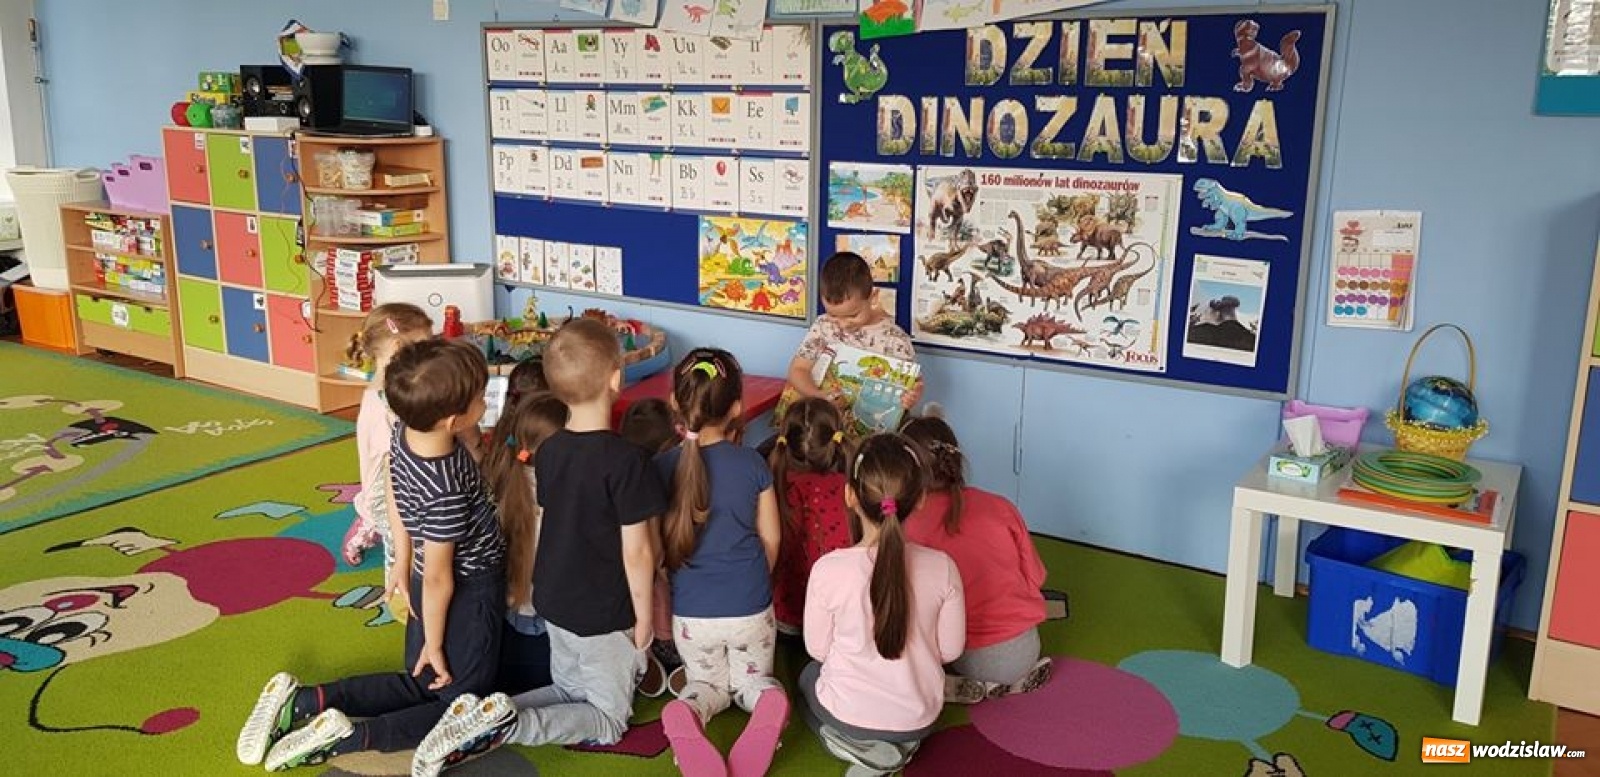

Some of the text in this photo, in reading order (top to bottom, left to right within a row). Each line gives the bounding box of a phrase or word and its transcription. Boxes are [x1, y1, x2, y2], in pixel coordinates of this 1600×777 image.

[550, 39, 568, 54] Aa
[612, 38, 628, 58] Yy
[673, 37, 696, 54] Uu
[965, 18, 1188, 87] DZIEŃ
[610, 100, 636, 115] Mm
[677, 99, 698, 117] Kk
[747, 101, 764, 118] Ee
[876, 93, 1282, 168] DINOZAURA
[499, 152, 514, 171] Pp
[554, 155, 573, 171] Dd
[613, 160, 634, 175] Nn
[679, 163, 697, 180] Bb
[749, 166, 764, 183] Ss
[981, 174, 1001, 186] 160
[1003, 174, 1054, 188] milionów
[1072, 177, 1141, 191] dinozaurów
